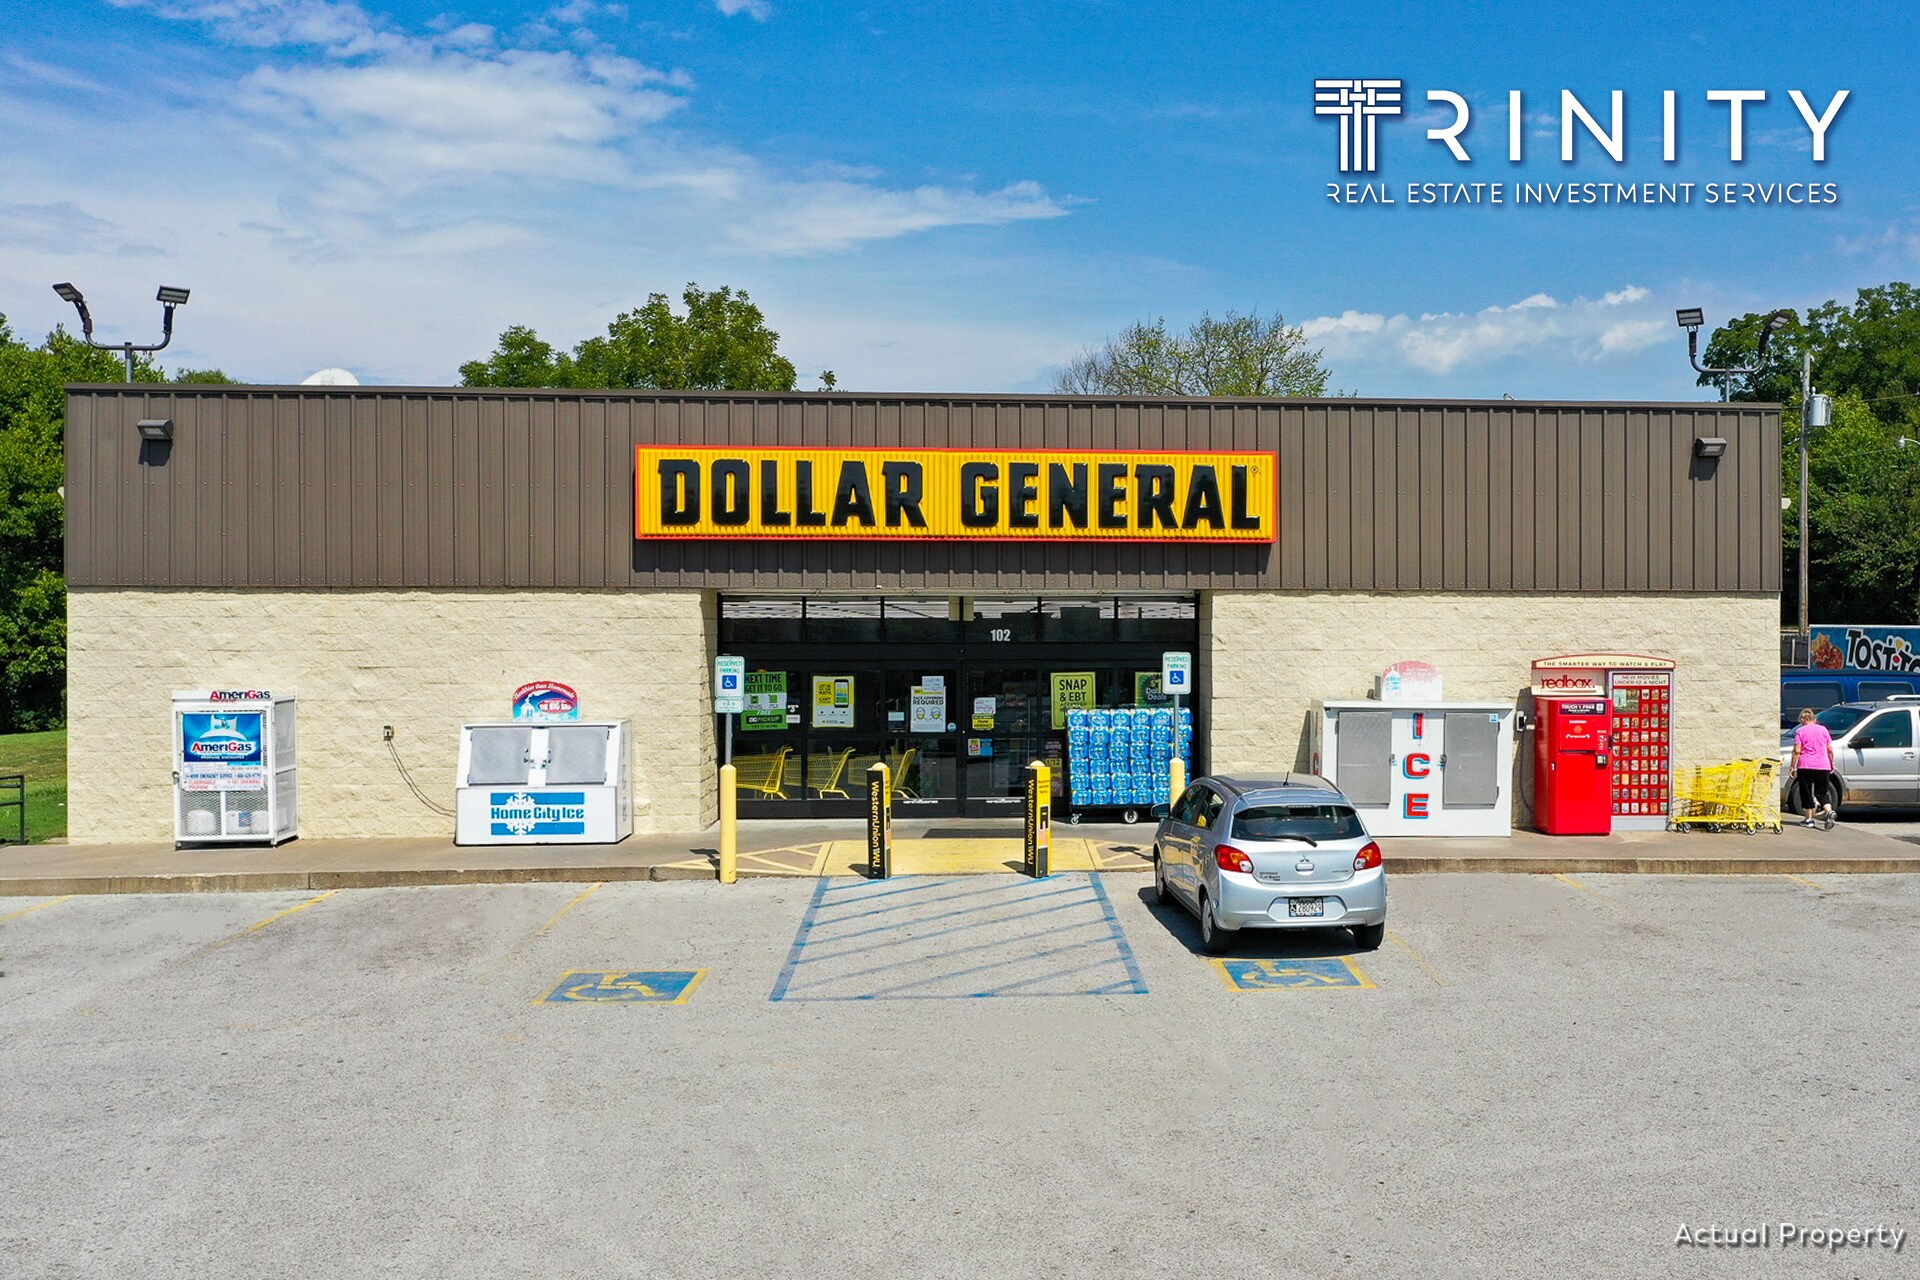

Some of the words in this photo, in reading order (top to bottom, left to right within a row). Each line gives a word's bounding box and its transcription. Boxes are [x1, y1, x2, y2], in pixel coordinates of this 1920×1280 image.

[657, 458, 929, 528] DOLLAR
[960, 460, 1261, 531] GENERAL
[990, 629, 1011, 641] 102
[744, 673, 763, 684] NEXT
[765, 673, 782, 683] TIME
[1059, 679, 1087, 690] SNAP
[210, 690, 271, 700] AmeriGas
[1060, 692, 1067, 701] &
[1069, 691, 1086, 701] EBT
[192, 742, 252, 752] AmeriGas
[491, 807, 531, 819] Home
[533, 806, 561, 821] City
[562, 807, 584, 819] Ice
